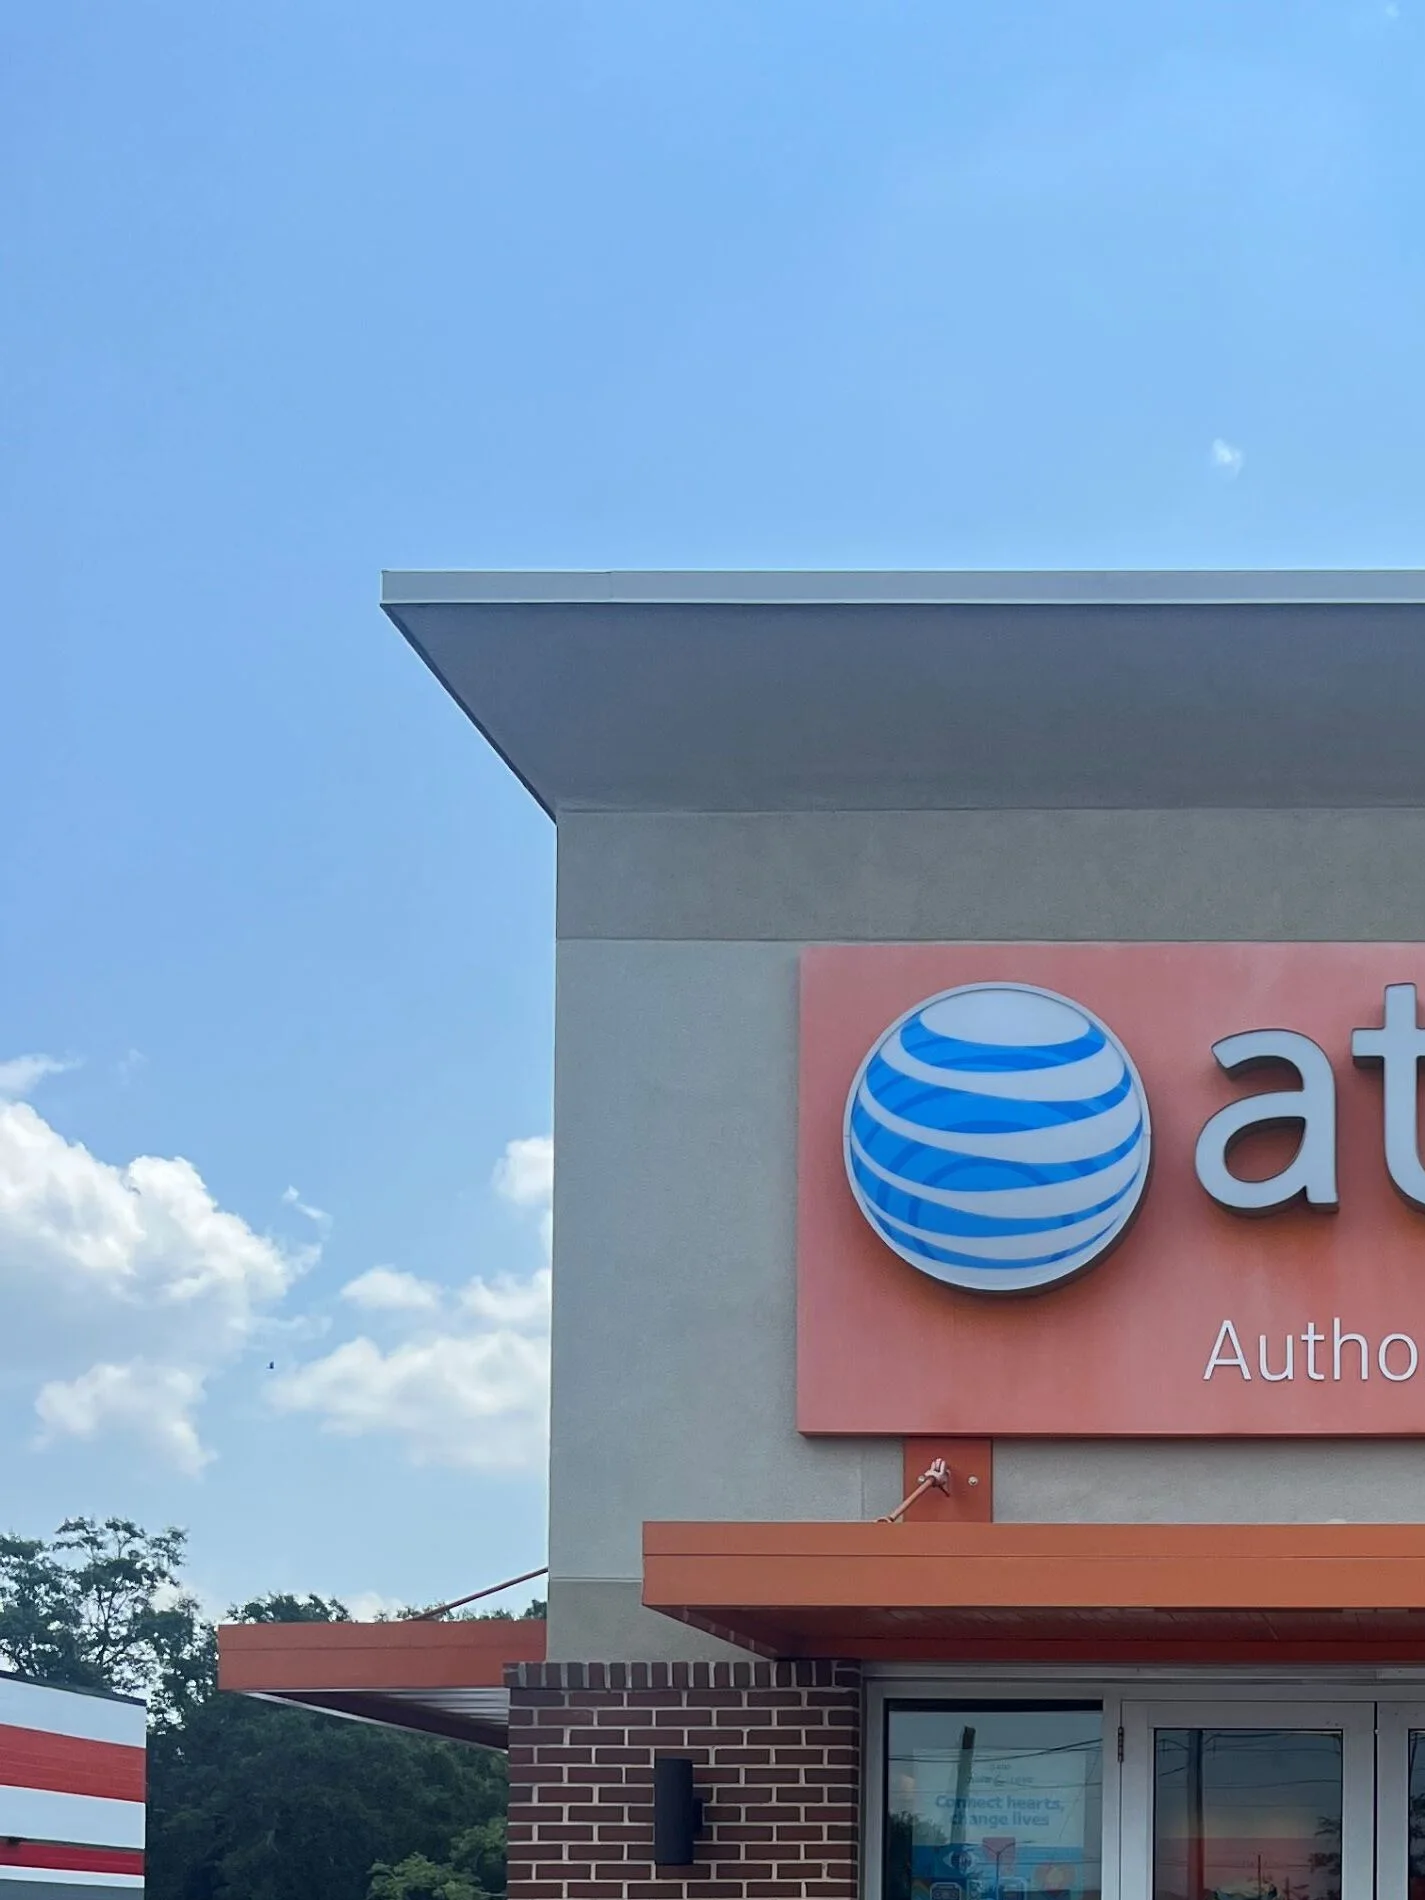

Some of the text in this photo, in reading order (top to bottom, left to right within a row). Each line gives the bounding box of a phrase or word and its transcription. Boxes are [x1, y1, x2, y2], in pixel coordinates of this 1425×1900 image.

[936, 1795, 1065, 1812] Connect hearts,
[952, 1812, 1050, 1829] change lives
